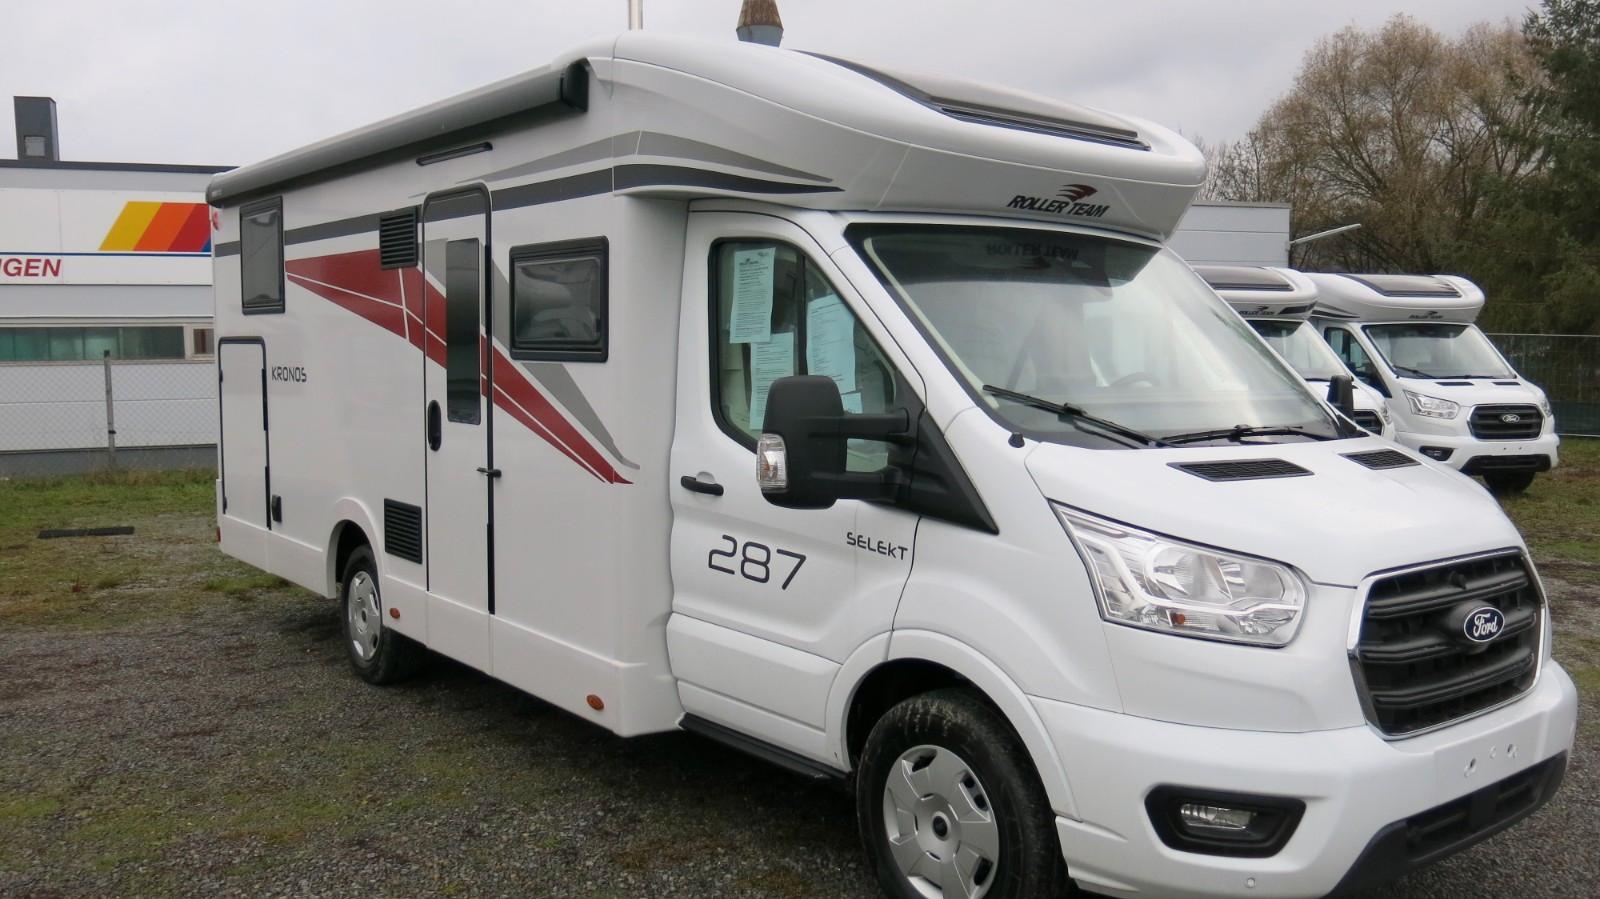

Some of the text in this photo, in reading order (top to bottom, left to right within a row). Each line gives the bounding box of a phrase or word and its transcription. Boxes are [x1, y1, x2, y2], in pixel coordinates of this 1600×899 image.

[1006, 195, 1110, 217] ROLLER TEAM
[0, 258, 62, 277] GEN
[271, 366, 307, 383] KRONOS
[846, 532, 908, 561] SELEKT
[708, 534, 807, 590] 287
[1473, 612, 1499, 637] Ford
